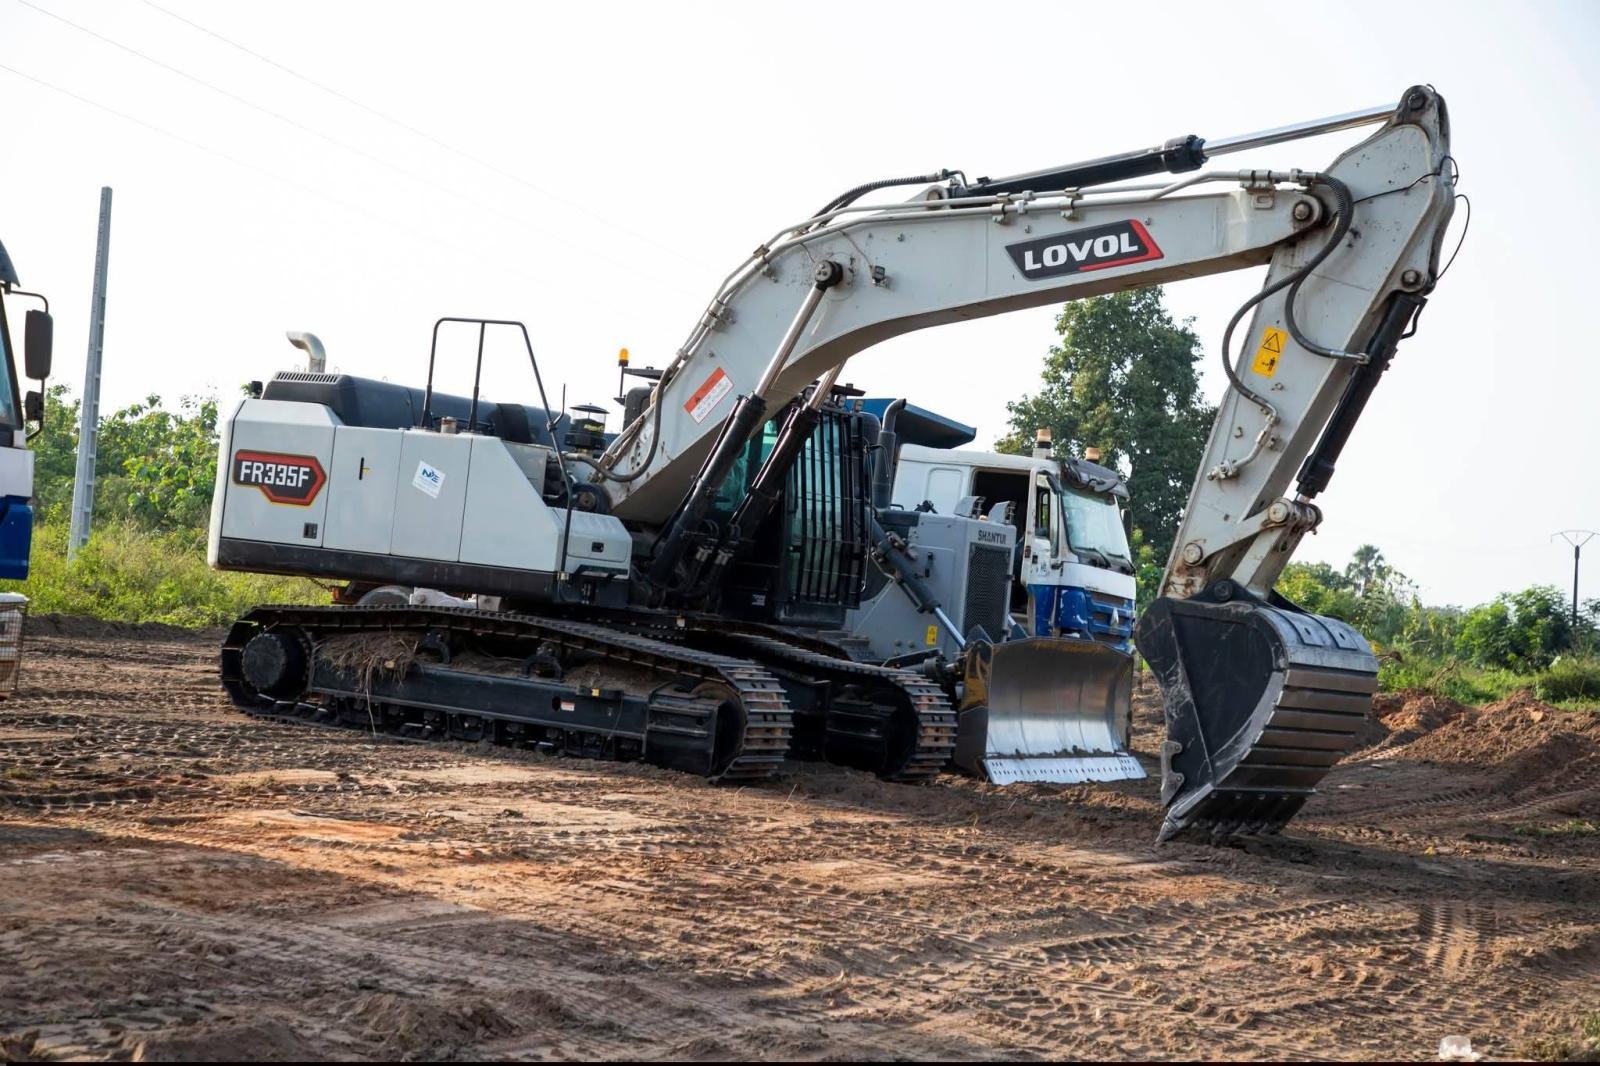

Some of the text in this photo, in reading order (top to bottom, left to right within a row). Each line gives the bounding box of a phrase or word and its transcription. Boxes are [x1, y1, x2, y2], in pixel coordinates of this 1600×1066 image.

[1024, 232, 1139, 271] LOVOL
[240, 461, 311, 488] FR335F
[978, 529, 1007, 545] SHANTUI
